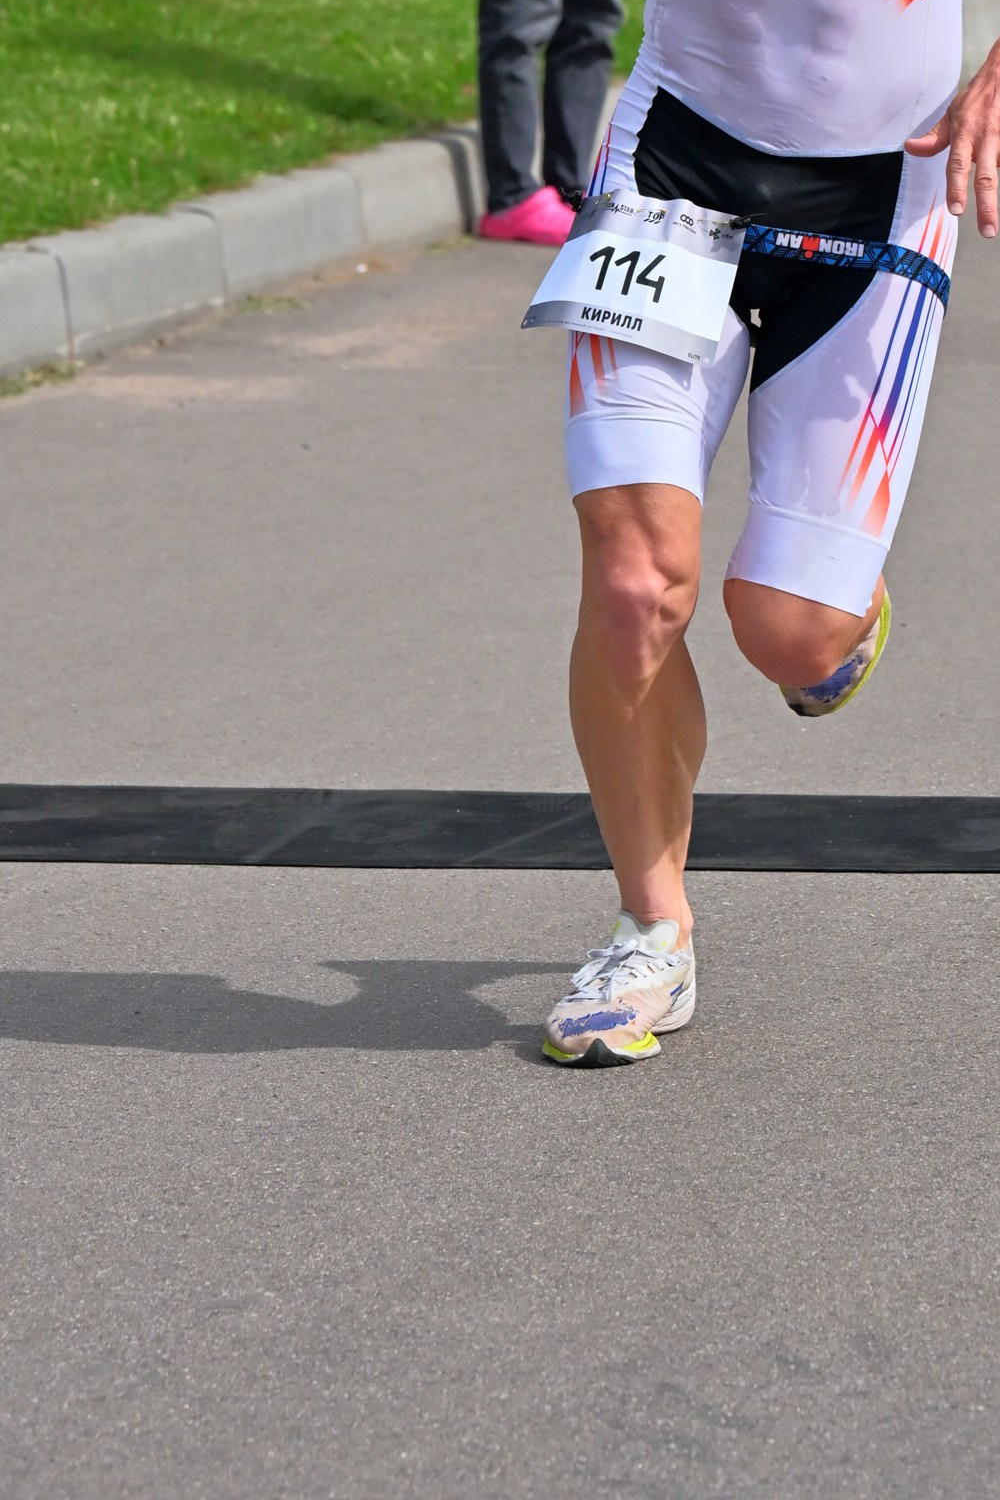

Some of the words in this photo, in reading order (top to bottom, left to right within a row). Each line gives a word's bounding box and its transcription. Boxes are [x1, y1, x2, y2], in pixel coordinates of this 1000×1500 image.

[647, 211, 665, 221] TOP
[775, 232, 865, 259] IRONMAN
[589, 246, 667, 304] 114
[581, 306, 644, 332] КИРИЛЛ
[687, 352, 701, 362] ELITE
